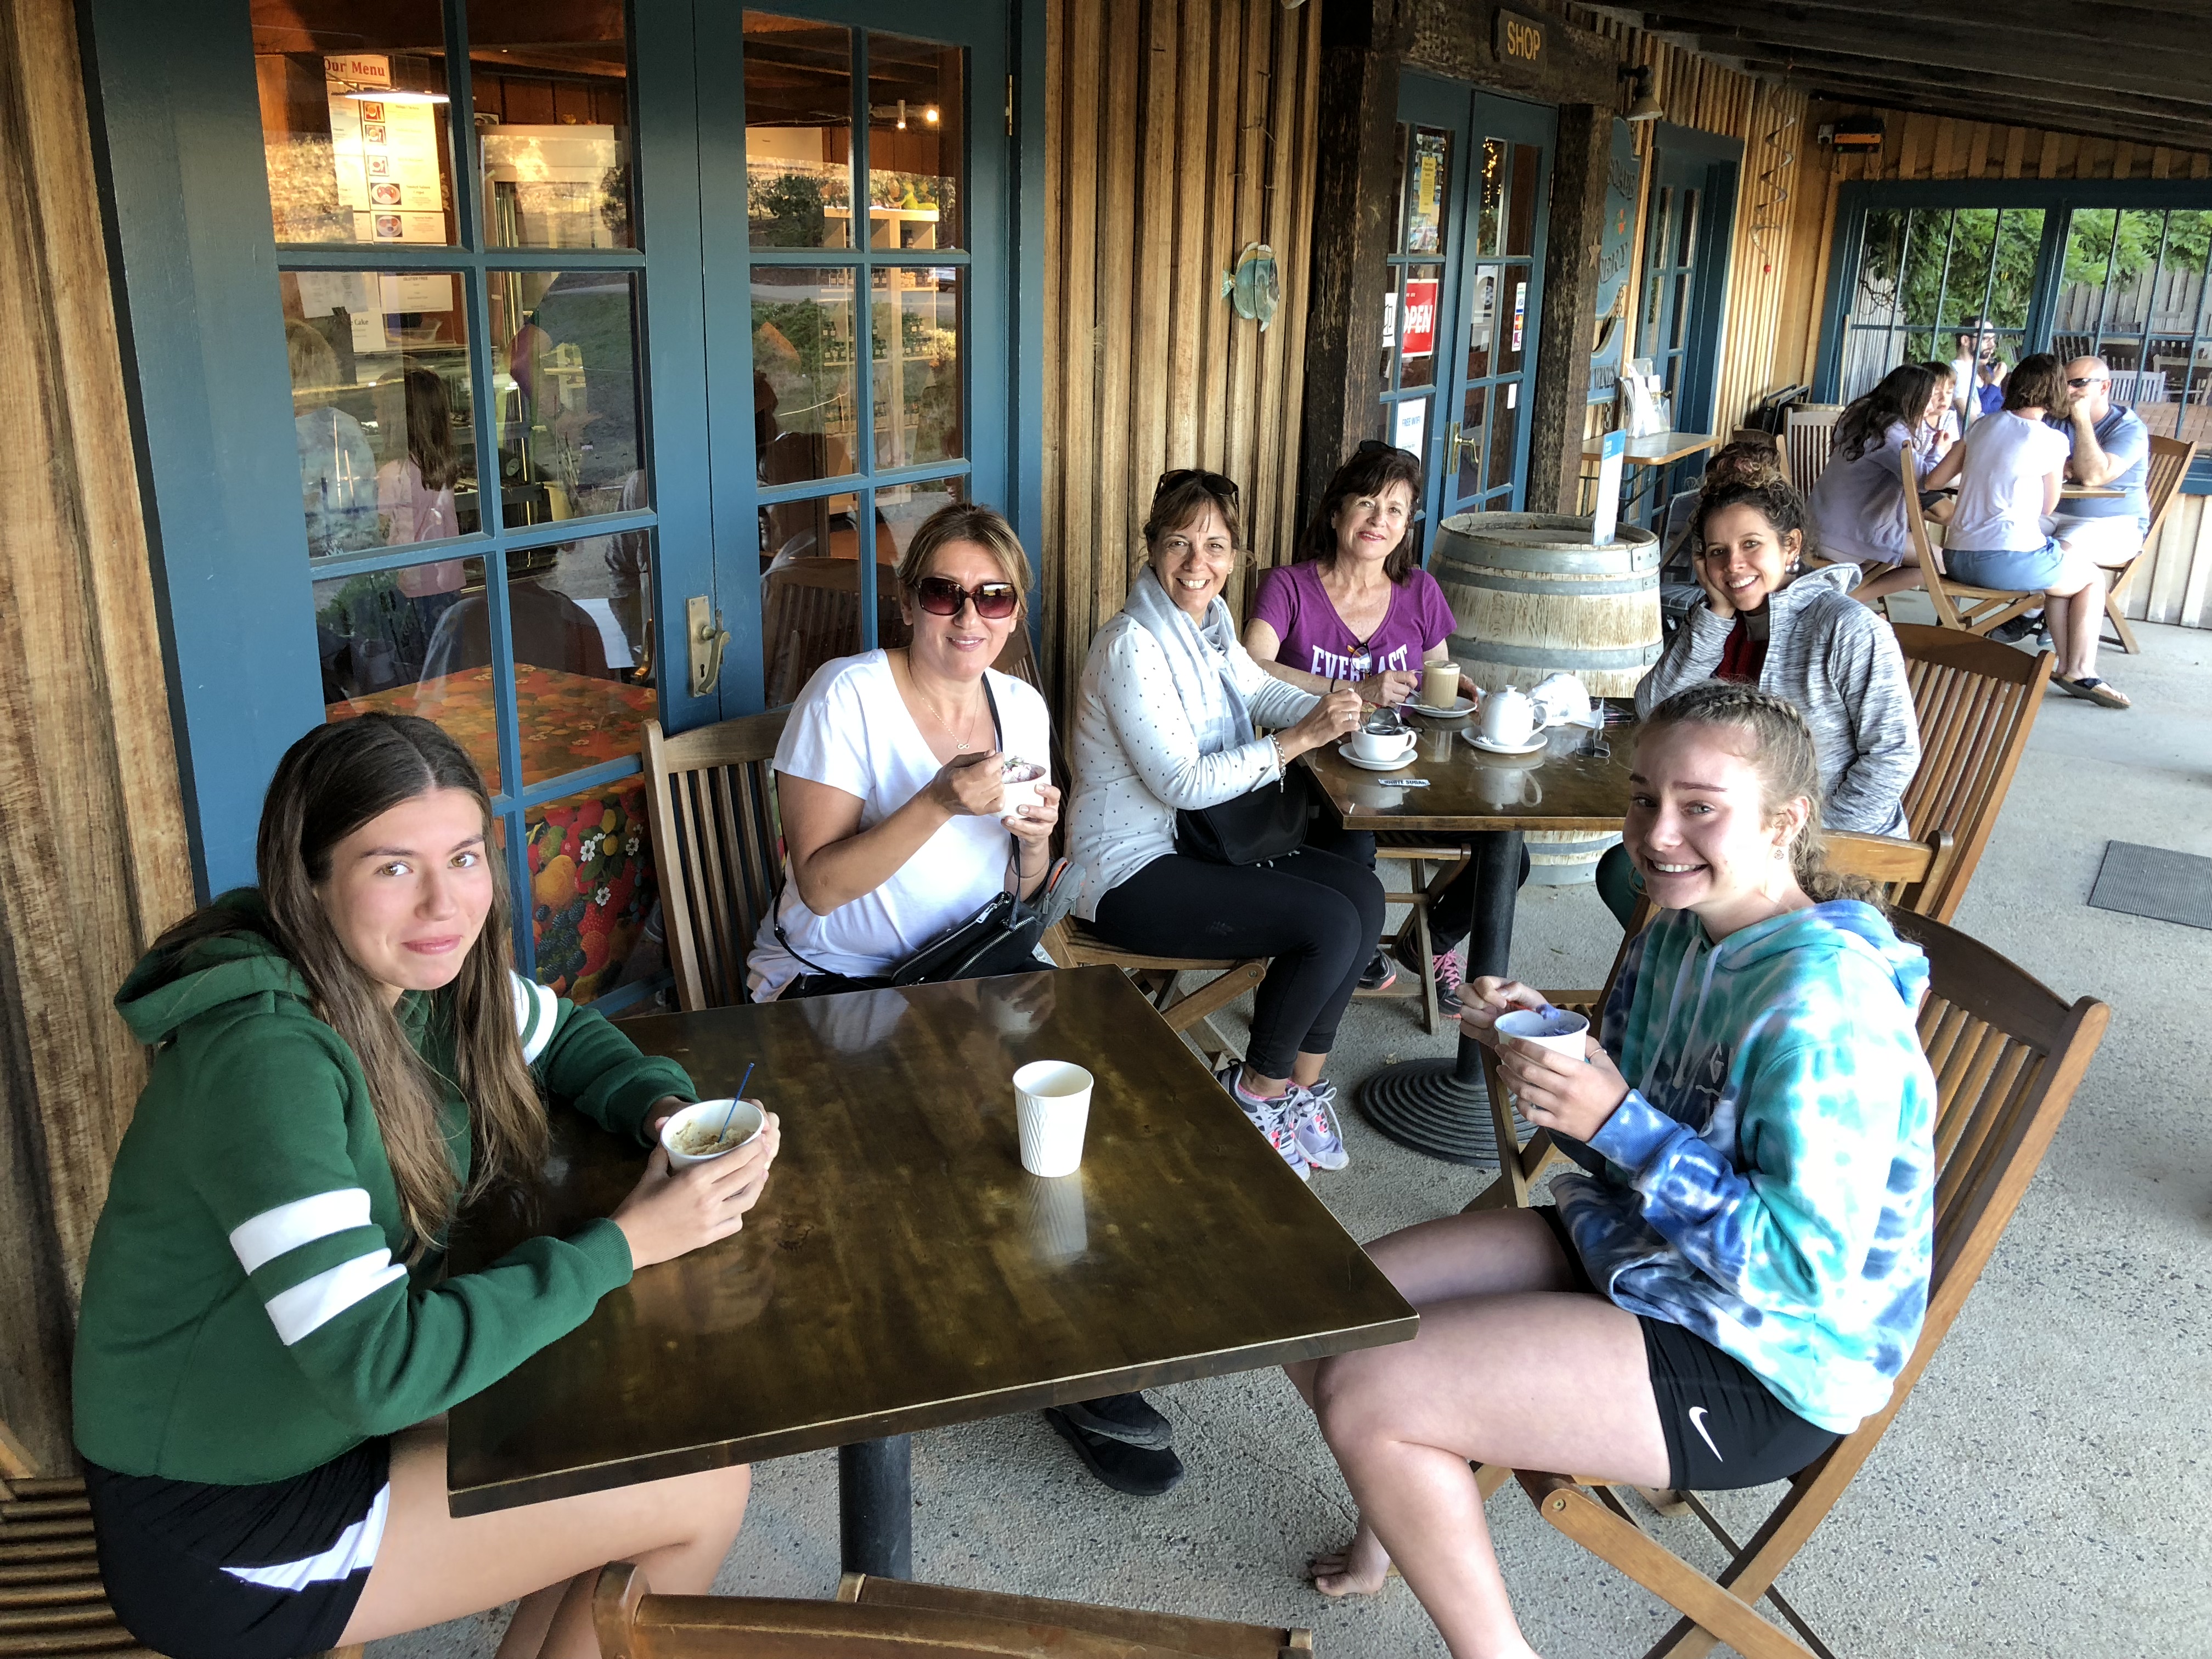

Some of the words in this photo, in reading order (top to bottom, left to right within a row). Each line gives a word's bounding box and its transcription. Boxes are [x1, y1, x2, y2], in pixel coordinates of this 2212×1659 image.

[1507, 20, 1541, 60] SHOP
[351, 61, 385, 76] Menu
[1403, 304, 1434, 334] OPEN
[1311, 644, 1408, 682] EVERAST
